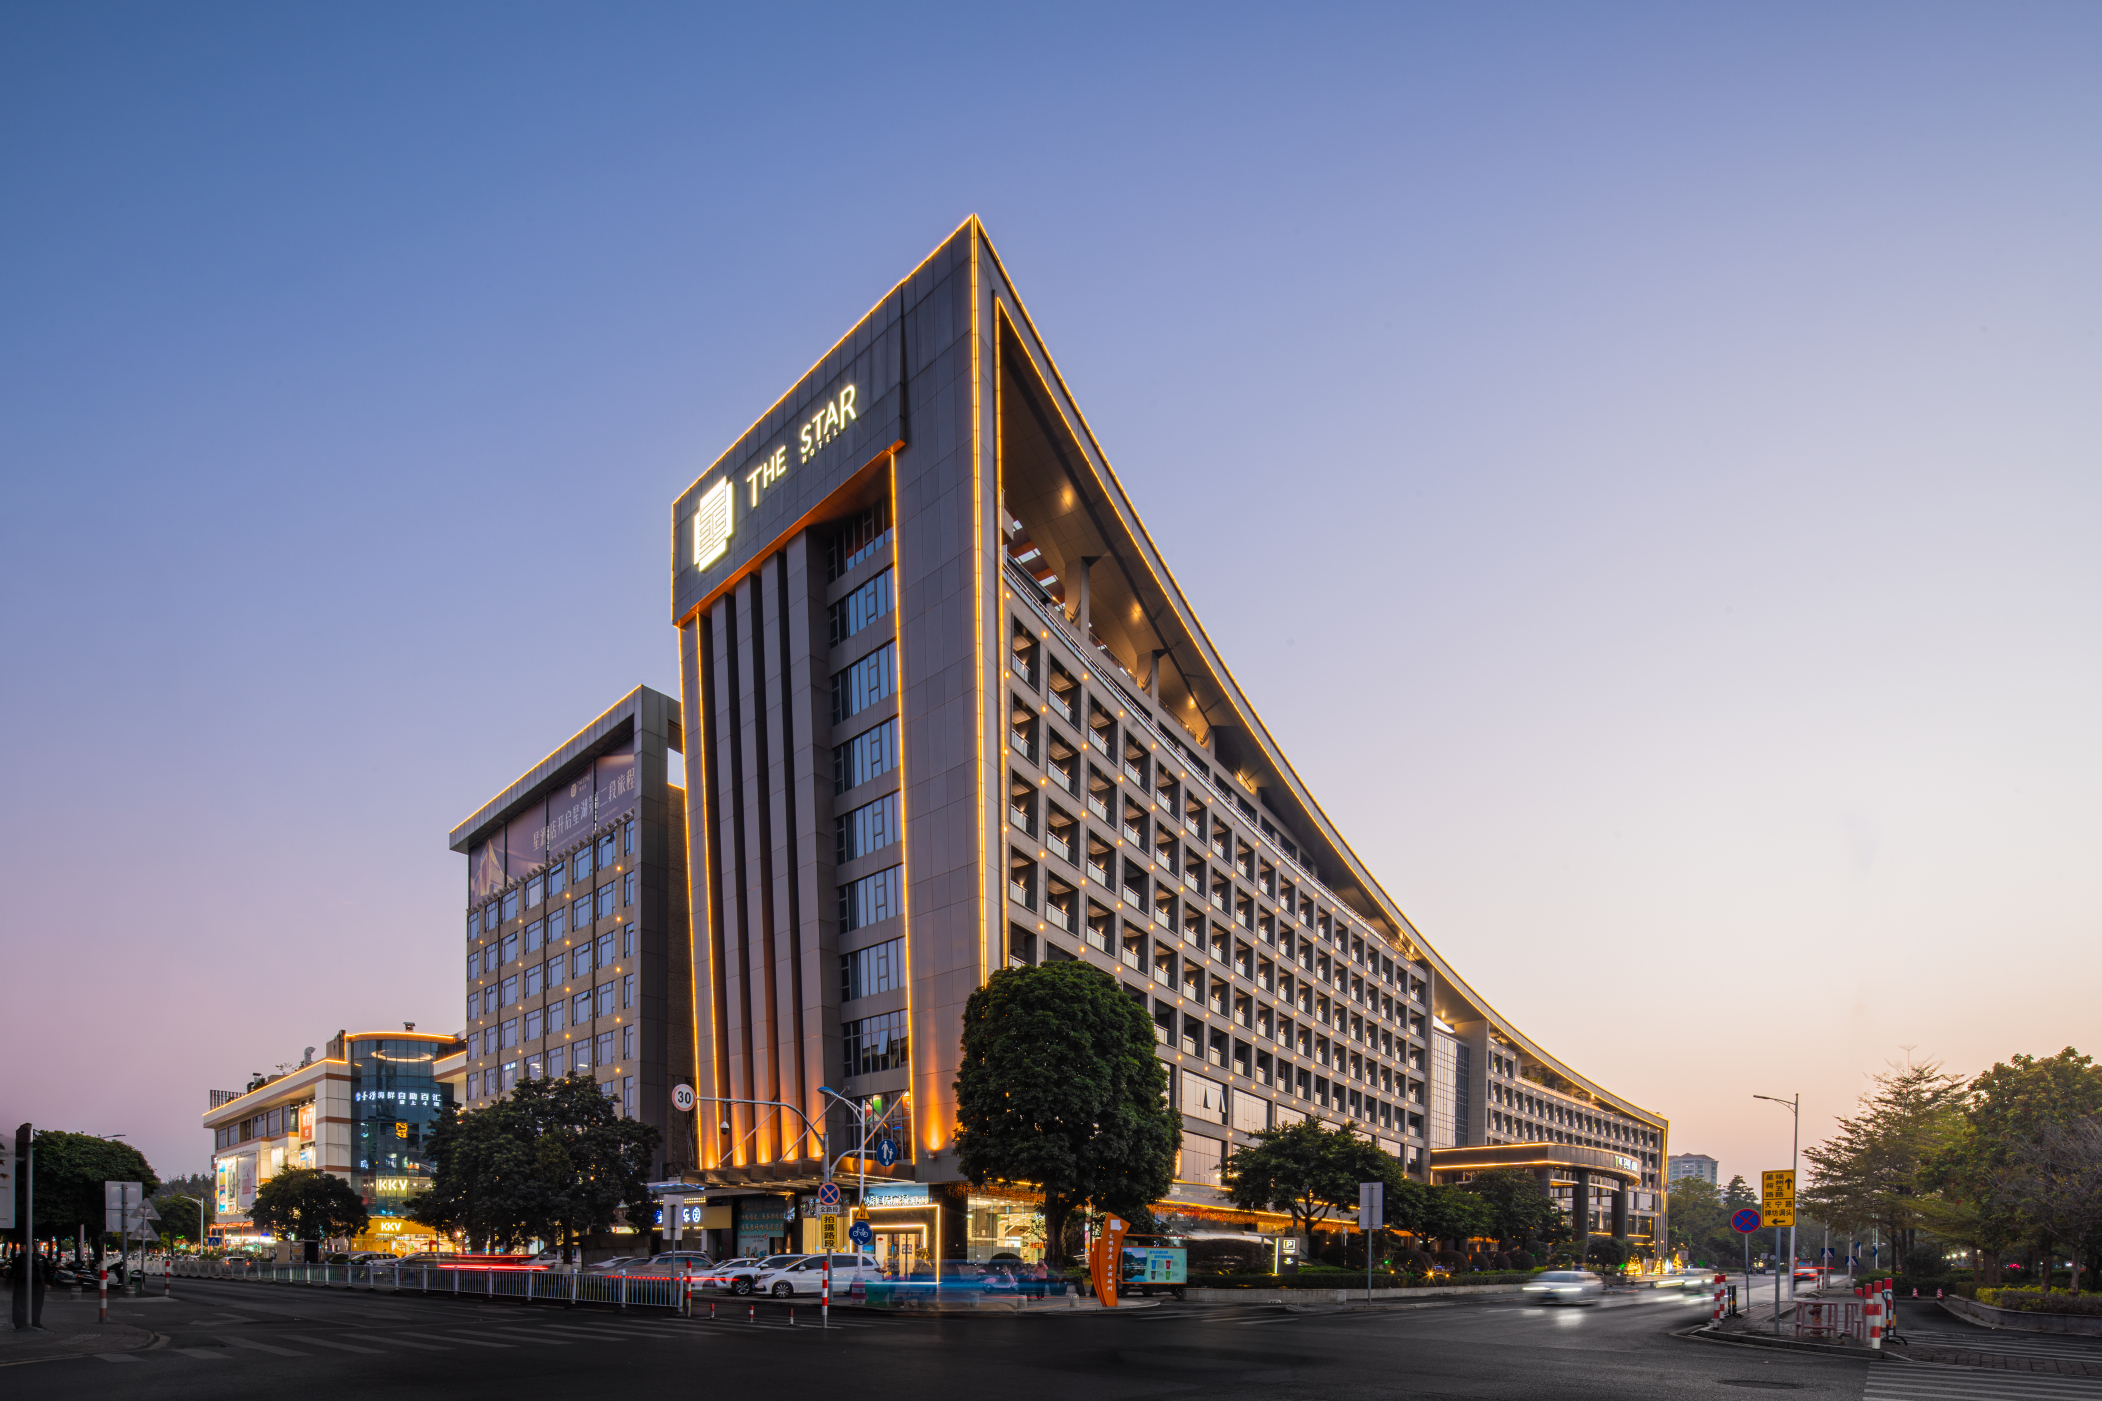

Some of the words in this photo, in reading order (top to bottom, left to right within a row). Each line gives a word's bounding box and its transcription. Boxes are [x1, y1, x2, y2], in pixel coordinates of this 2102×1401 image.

[746, 445, 787, 508] THE
[800, 384, 858, 454] STAR
[802, 428, 839, 464] HOTEL
[677, 1091, 692, 1104] 30
[378, 1179, 408, 1191] KKV
[1775, 1173, 1784, 1198] 端州五路
[381, 1222, 402, 1231] KKV
[824, 1215, 835, 1248] 拍摄路段
